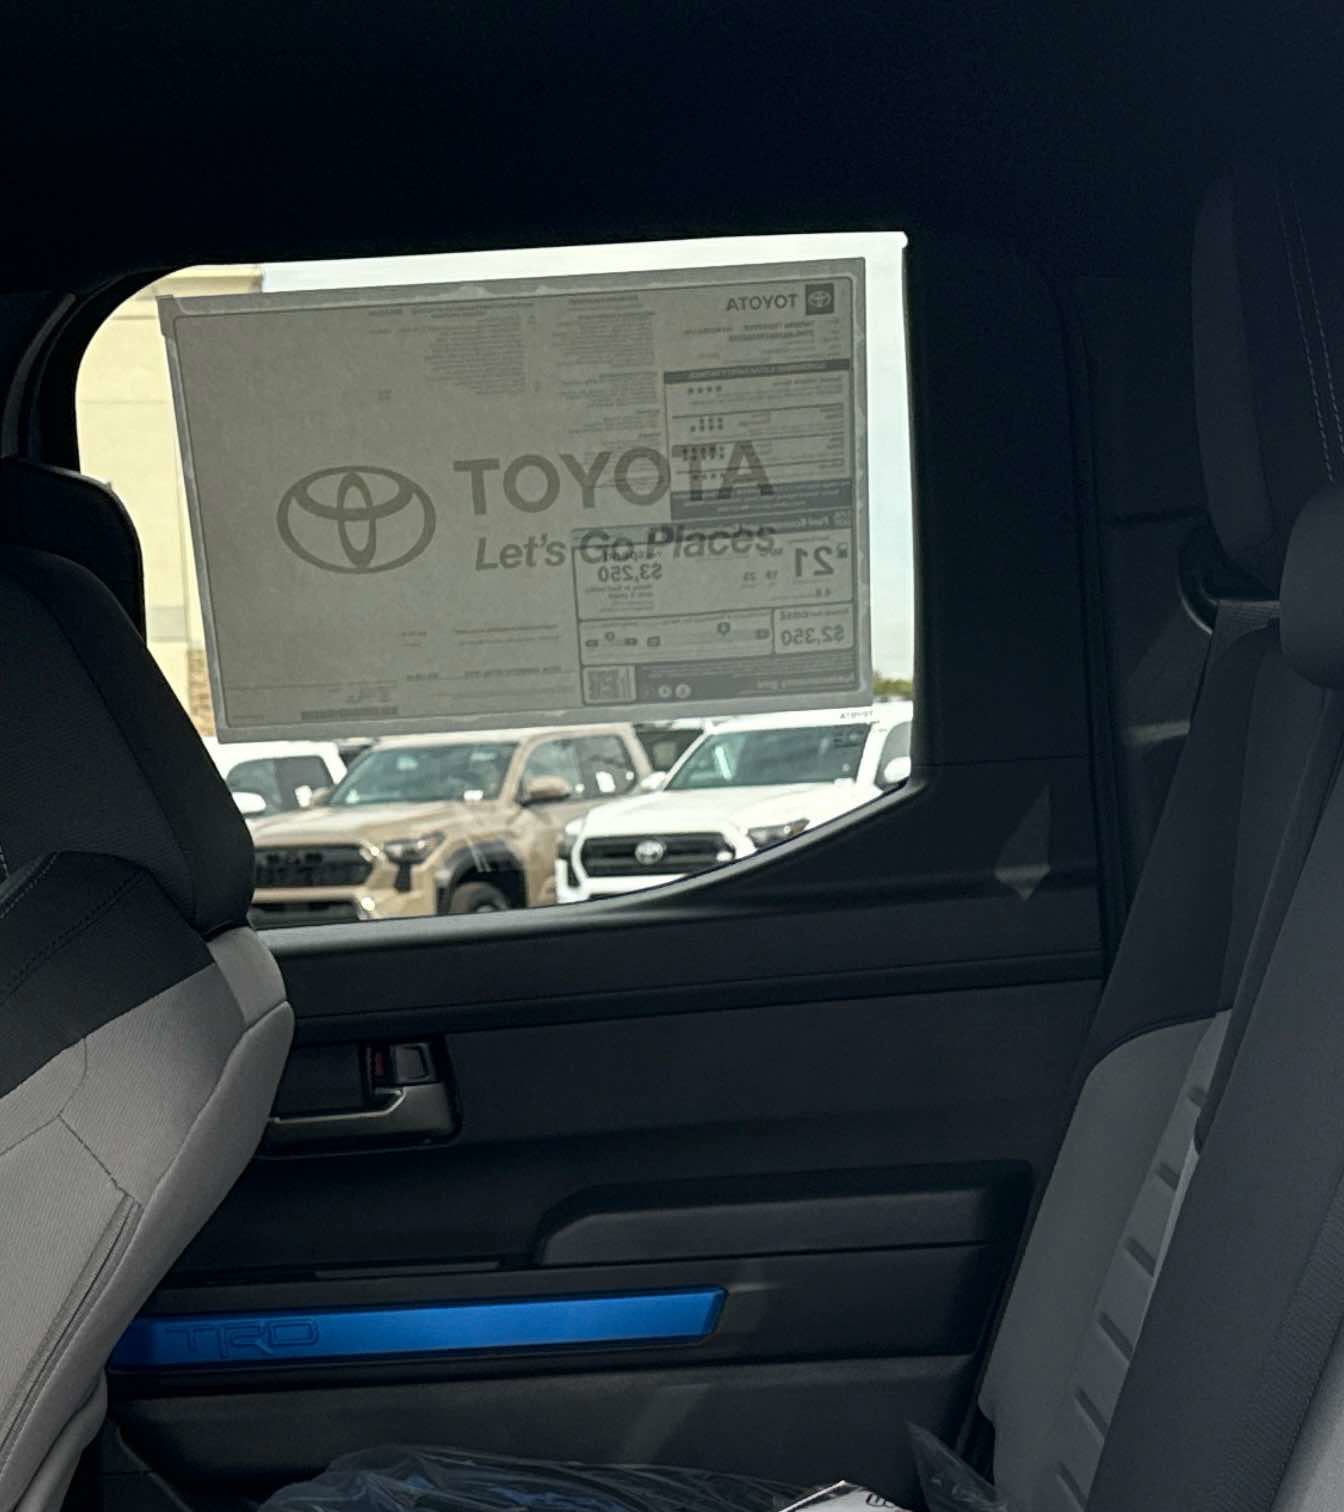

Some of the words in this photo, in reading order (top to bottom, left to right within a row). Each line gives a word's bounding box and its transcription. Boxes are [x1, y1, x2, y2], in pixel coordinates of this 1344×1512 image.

[453, 440, 776, 515] TOYOTA
[475, 534, 567, 572] Let's
[580, 528, 643, 566] Go
[165, 1318, 320, 1359] TRD
